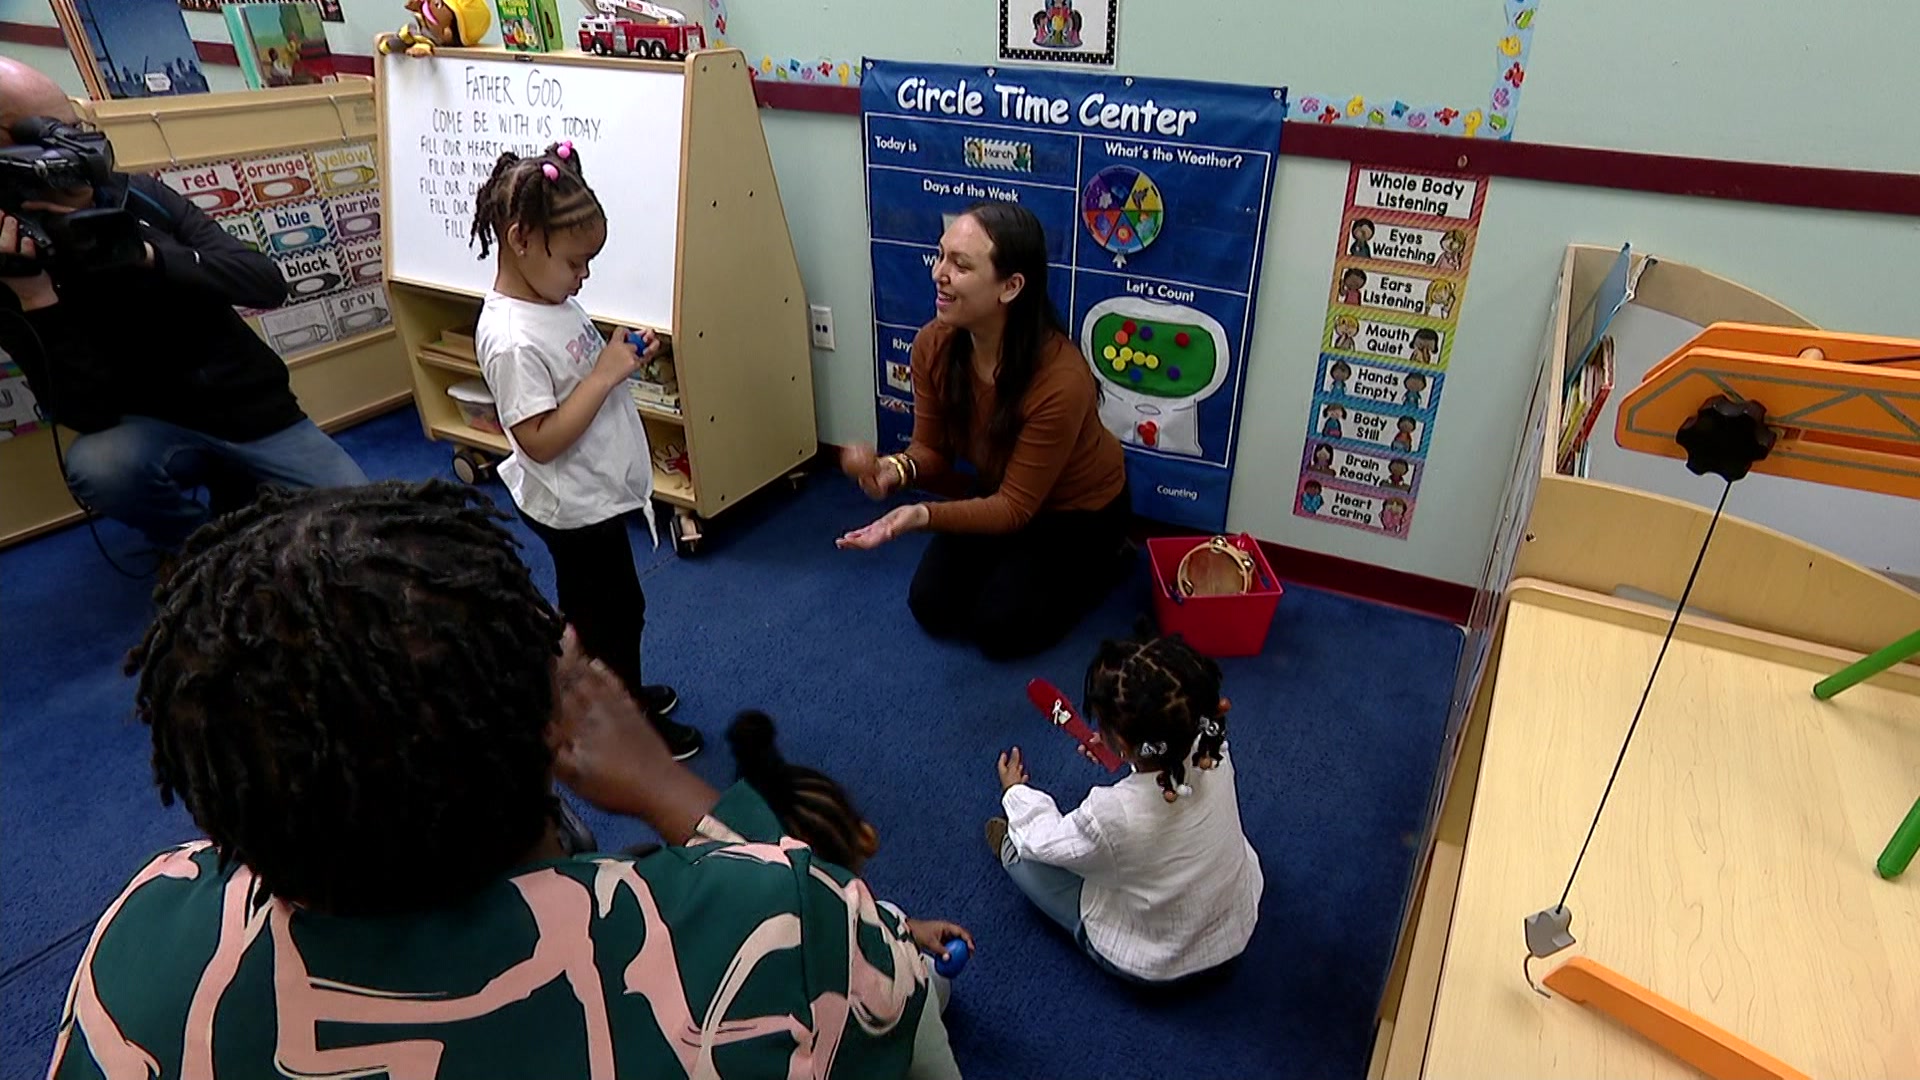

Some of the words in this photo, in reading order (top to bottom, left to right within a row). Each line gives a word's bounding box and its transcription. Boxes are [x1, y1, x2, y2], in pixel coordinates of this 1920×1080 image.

[465, 66, 515, 105] FATHER
[896, 77, 984, 117] Circle
[994, 84, 1069, 125] Time
[1079, 93, 1198, 137] Center
[432, 108, 463, 134] COME
[473, 110, 487, 133] BE
[499, 113, 529, 137] WITH
[536, 115, 552, 138] US
[420, 135, 438, 155] FILL
[443, 138, 461, 156] OUR
[874, 136, 906, 156] Today
[908, 140, 917, 153] is
[984, 147, 1014, 160] March
[1105, 142, 1149, 162] What's
[1152, 146, 1174, 164] the
[1177, 148, 1243, 169] Weather?
[246, 158, 305, 179] orange
[318, 149, 368, 169] yellow
[429, 158, 445, 176] FILL
[450, 160, 465, 176] OUR
[181, 169, 220, 191] red
[420, 177, 437, 195] FILL
[444, 180, 461, 196] OUR
[1369, 172, 1417, 192] Whole
[1422, 178, 1465, 200] Body
[923, 179, 950, 196] Days
[952, 182, 964, 195] of
[967, 184, 985, 198] the
[987, 186, 1019, 203] Week
[335, 195, 380, 218] purple
[430, 198, 447, 215] FILL
[453, 198, 470, 216] OUR
[1377, 192, 1449, 217] Listening
[275, 209, 311, 229] blue
[444, 218, 465, 239] FILL
[1389, 229, 1423, 246] Eyes
[1372, 242, 1436, 266] Watching
[286, 256, 330, 278] black
[1126, 280, 1154, 296] Let's
[1157, 285, 1195, 303] Count
[1380, 276, 1413, 293] Ears
[340, 291, 376, 314] gray
[1363, 289, 1424, 313] Listening
[1366, 323, 1410, 342] Mouth
[1366, 338, 1403, 355] Quiet
[1357, 368, 1399, 386] Hands
[1354, 382, 1398, 402] Empty
[1353, 413, 1387, 431] Body
[1356, 426, 1380, 442] Still
[1345, 454, 1380, 472] Brain
[1339, 467, 1381, 487] Ready
[1156, 484, 1198, 501] Counting
[1334, 492, 1372, 510] Heart
[1331, 505, 1372, 524] Caring
